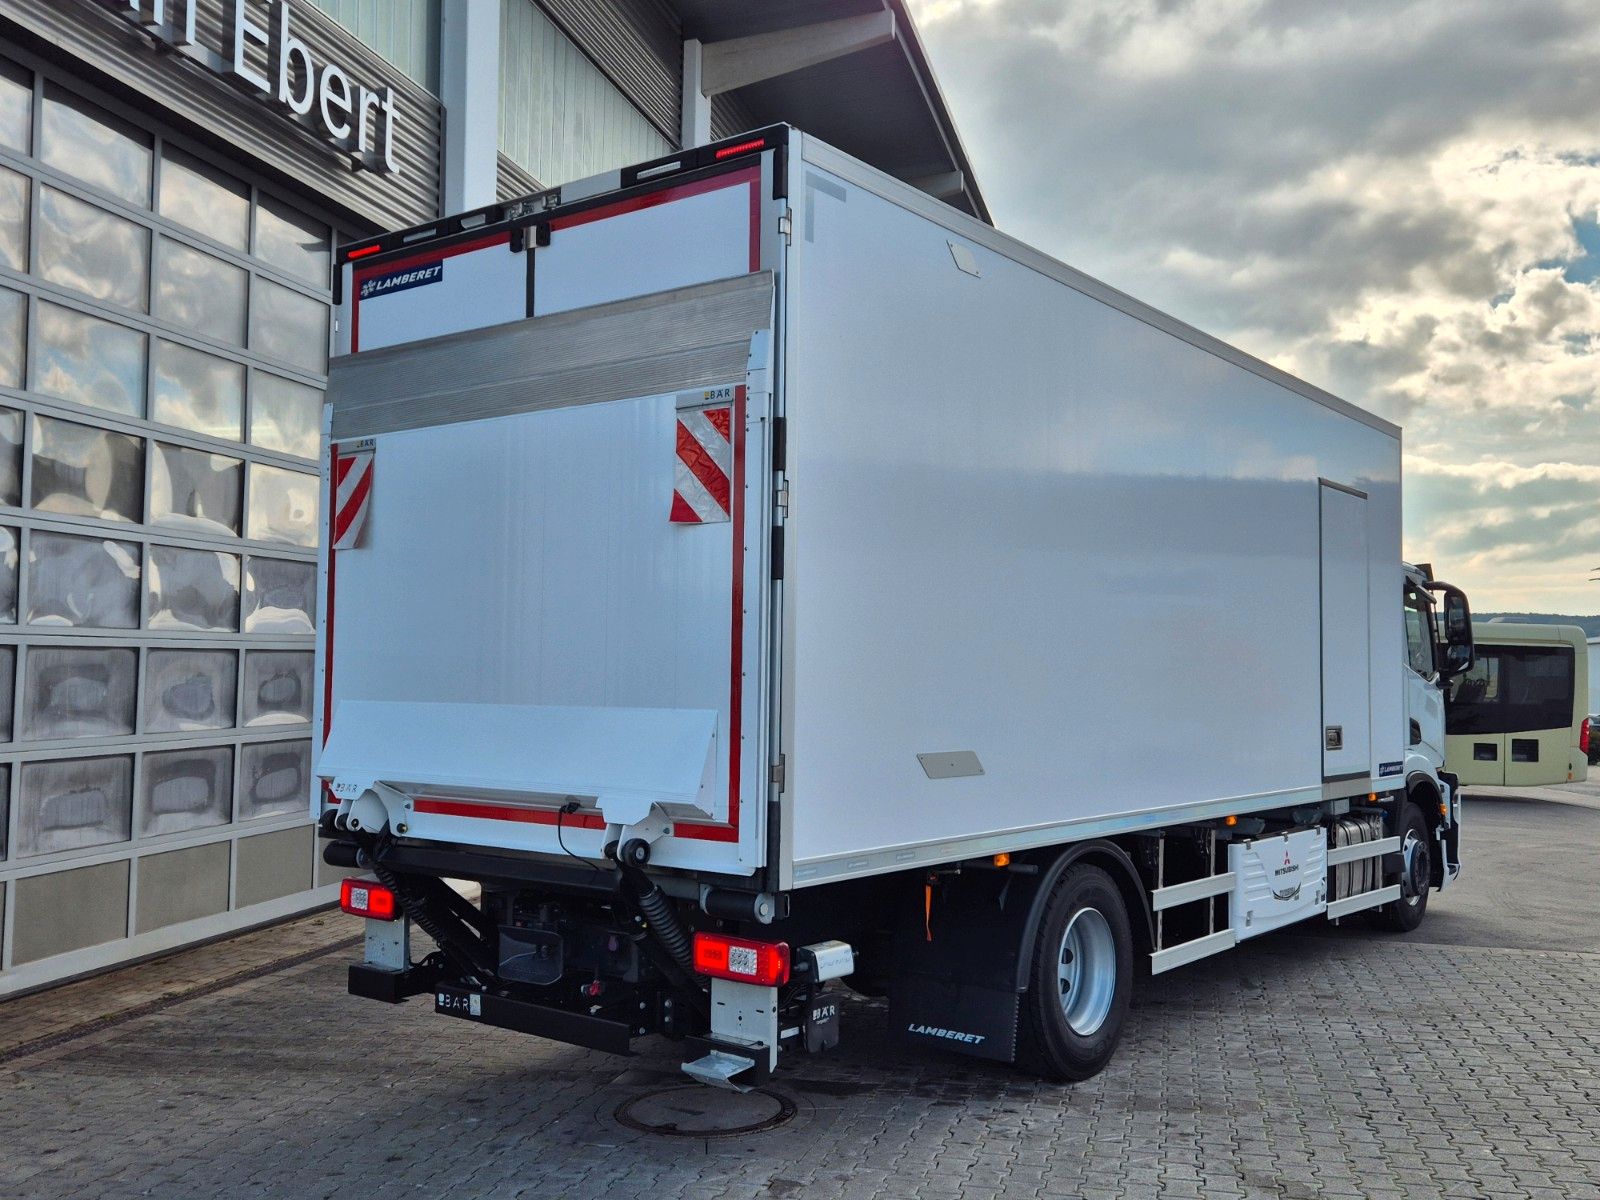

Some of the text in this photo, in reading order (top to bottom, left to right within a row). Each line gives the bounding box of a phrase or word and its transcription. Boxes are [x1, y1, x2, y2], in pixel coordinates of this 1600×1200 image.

[234, 0, 400, 173] Ebert
[376, 265, 442, 291] LAMBERET
[908, 1023, 985, 1044] LAMBERET
